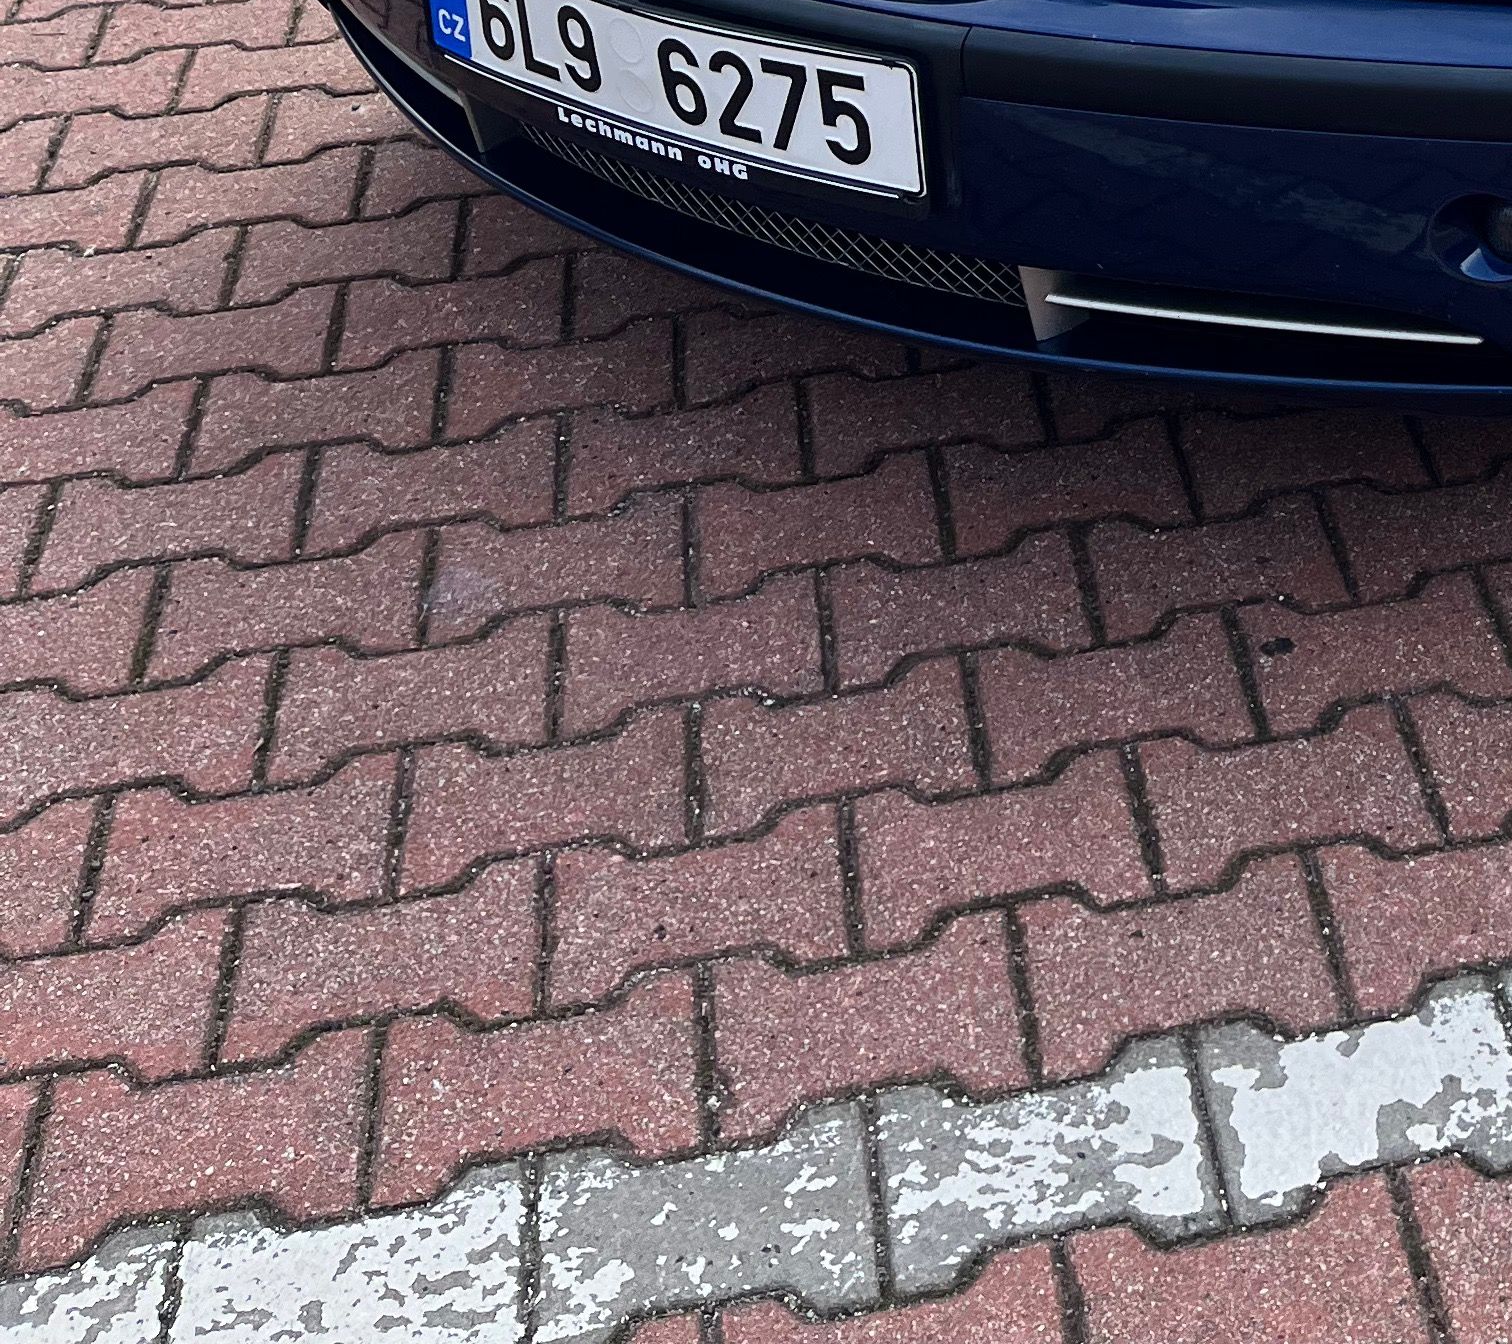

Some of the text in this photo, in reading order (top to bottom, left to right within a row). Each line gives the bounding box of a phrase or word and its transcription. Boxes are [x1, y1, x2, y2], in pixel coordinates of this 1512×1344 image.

[437, 7, 467, 43] CZ
[657, 38, 872, 165] 6275
[557, 106, 749, 180] Lechmann oHG
